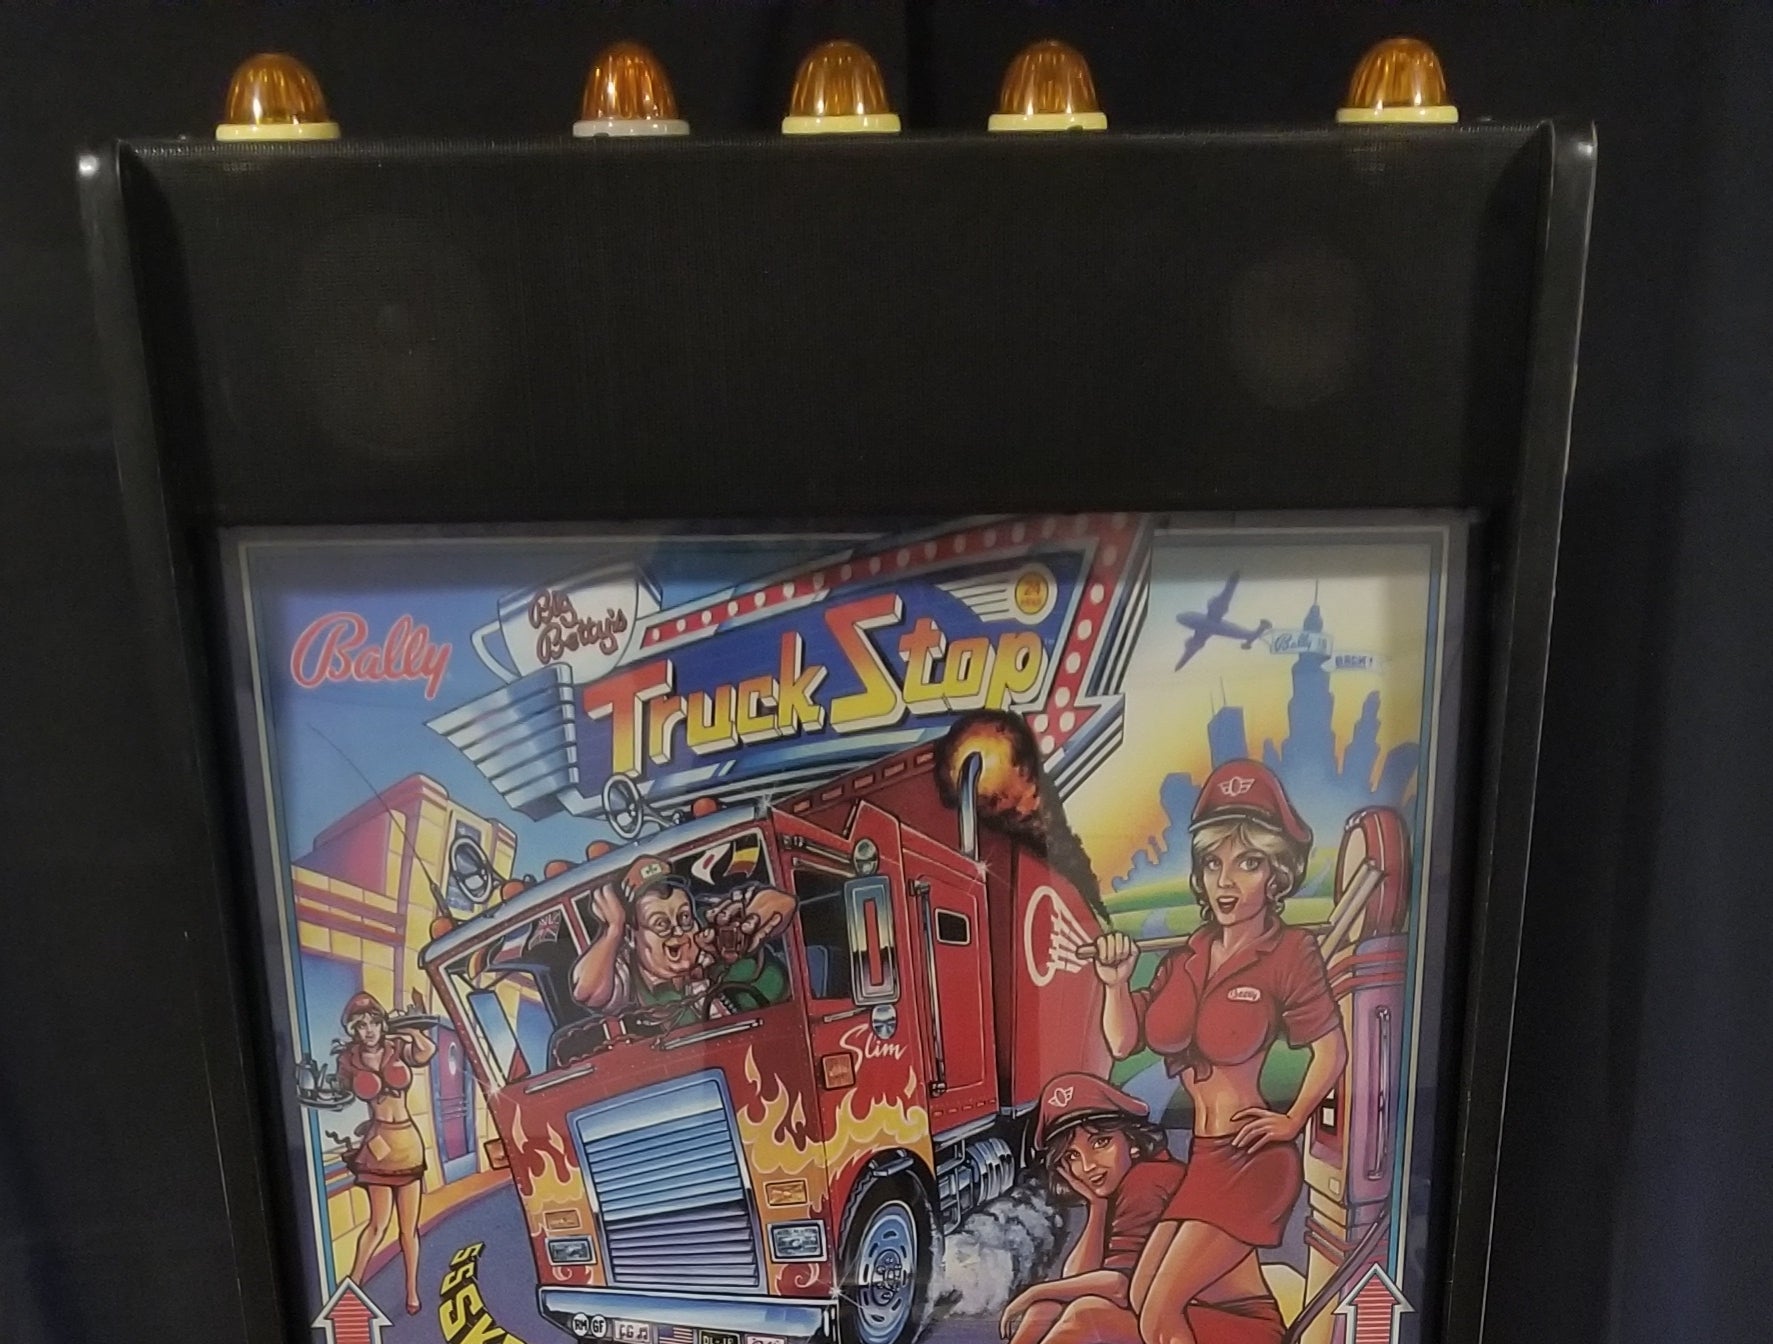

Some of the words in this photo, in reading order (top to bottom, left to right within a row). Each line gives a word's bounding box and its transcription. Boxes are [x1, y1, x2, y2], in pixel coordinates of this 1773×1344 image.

[528, 589, 577, 628] Big
[537, 608, 628, 665] Betty's
[290, 610, 453, 700] Bally
[584, 631, 826, 778] Truck
[823, 592, 1053, 730] Stop
[838, 1022, 908, 1064] Slim
